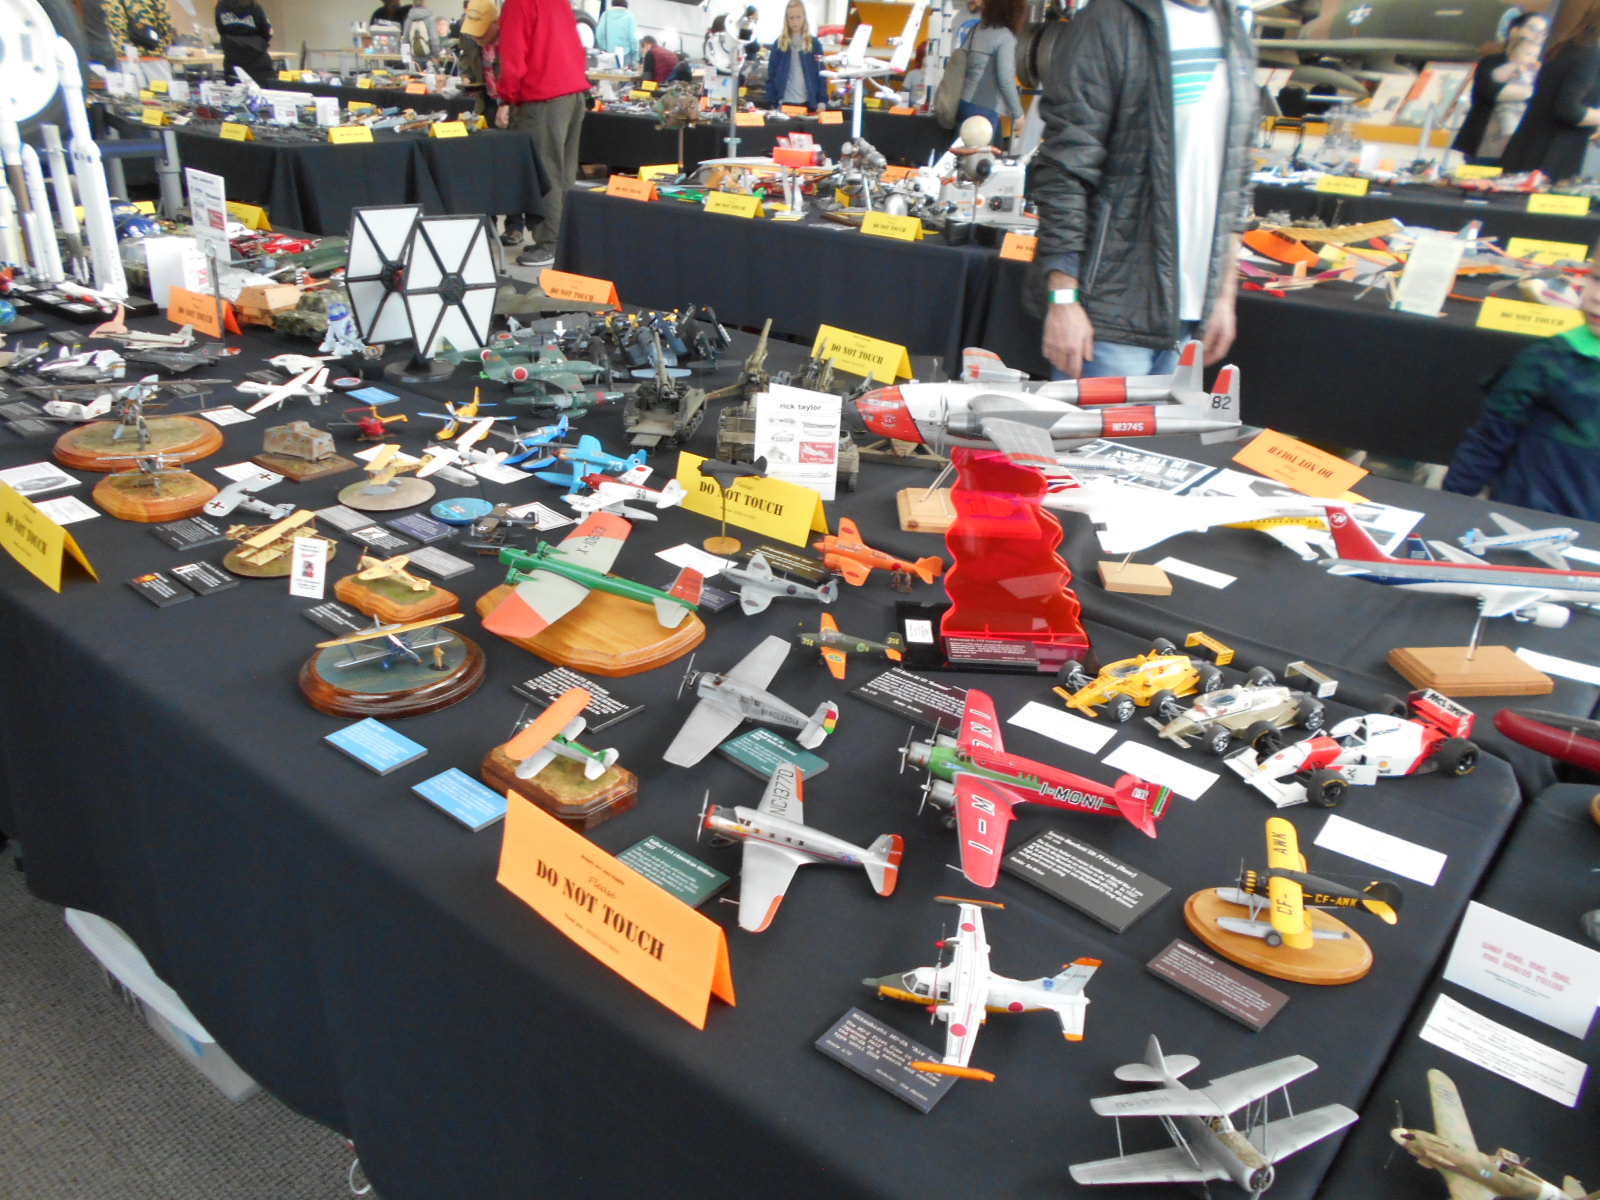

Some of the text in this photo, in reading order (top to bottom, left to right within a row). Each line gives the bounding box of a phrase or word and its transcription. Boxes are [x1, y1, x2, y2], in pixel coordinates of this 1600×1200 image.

[858, 351, 884, 365] TOUCH
[1211, 394, 1231, 410] 82
[607, 460, 623, 471] 73
[1266, 446, 1334, 478] DO NOT TOUCH
[699, 480, 715, 493] DO
[744, 495, 784, 516] TOUCH
[1039, 783, 1105, 811] I-MONI
[535, 859, 666, 962] DO NOT TOUCH
[1314, 894, 1359, 907] CF-AWK
